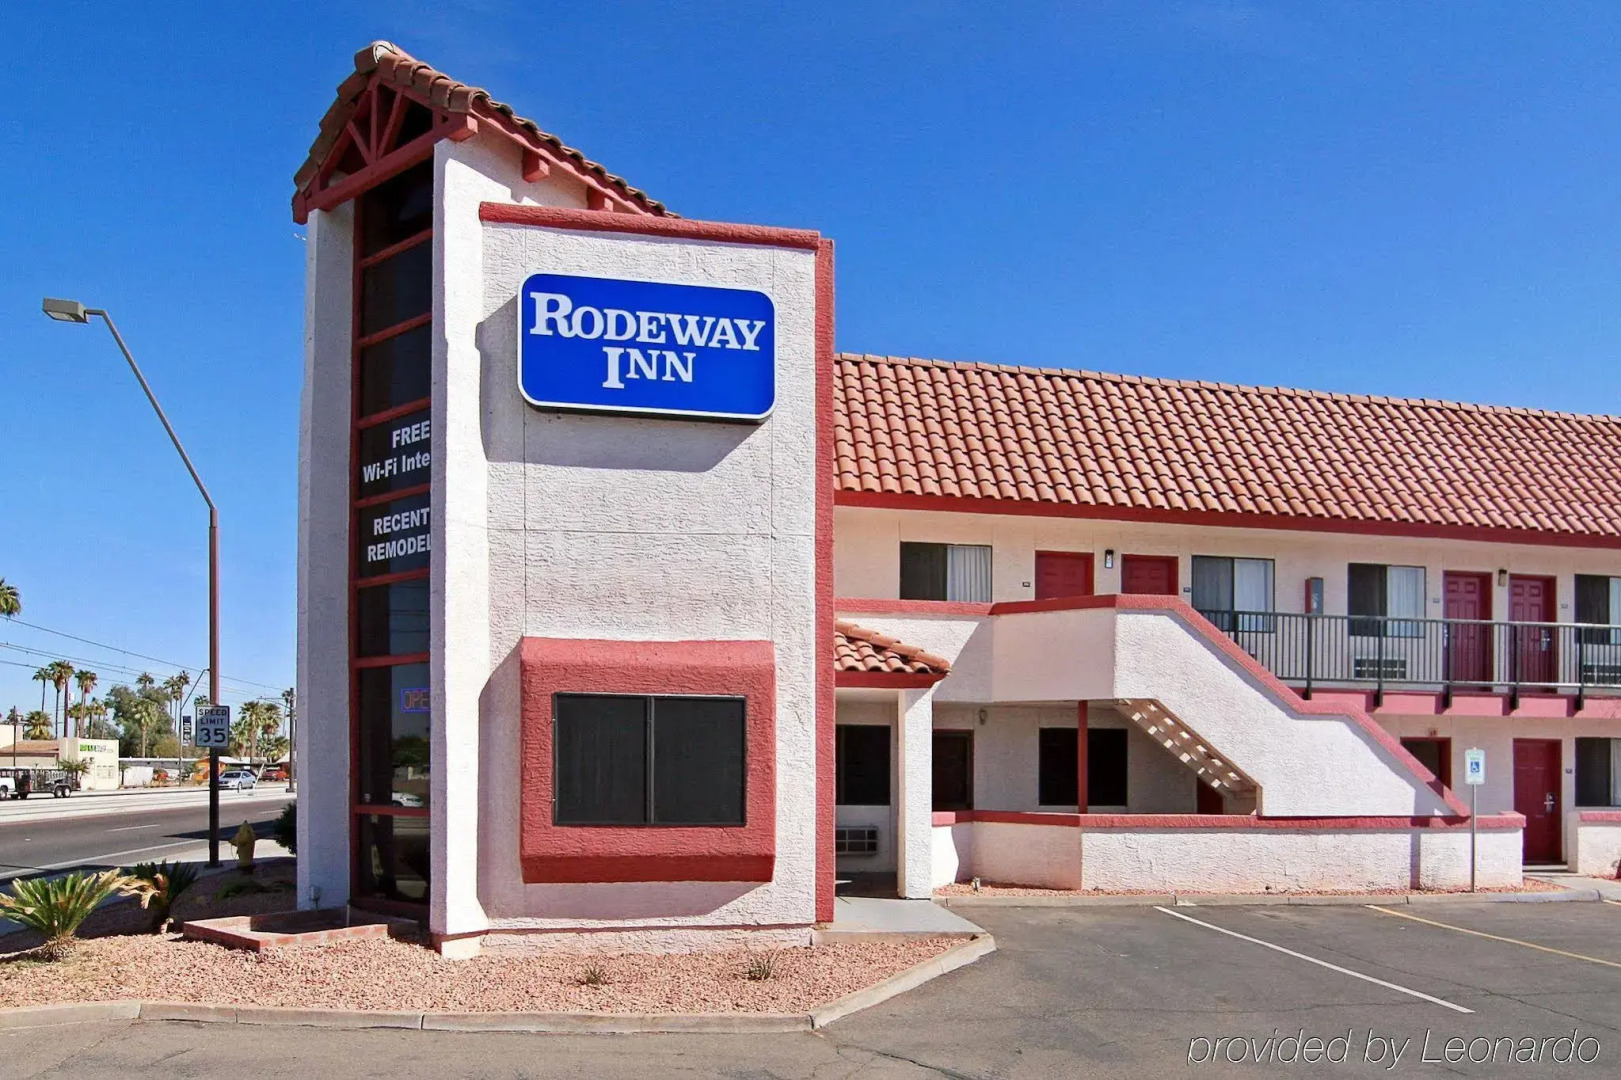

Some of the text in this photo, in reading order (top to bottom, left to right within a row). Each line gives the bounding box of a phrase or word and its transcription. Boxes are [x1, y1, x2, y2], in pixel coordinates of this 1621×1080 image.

[529, 292, 766, 351] RODEWAY
[602, 346, 697, 389] INN
[392, 420, 430, 449] FREE
[363, 452, 430, 483] Wi-Fi Inte
[373, 507, 430, 536] RECENT
[198, 708, 227, 716] SPEED
[199, 727, 226, 743] 35
